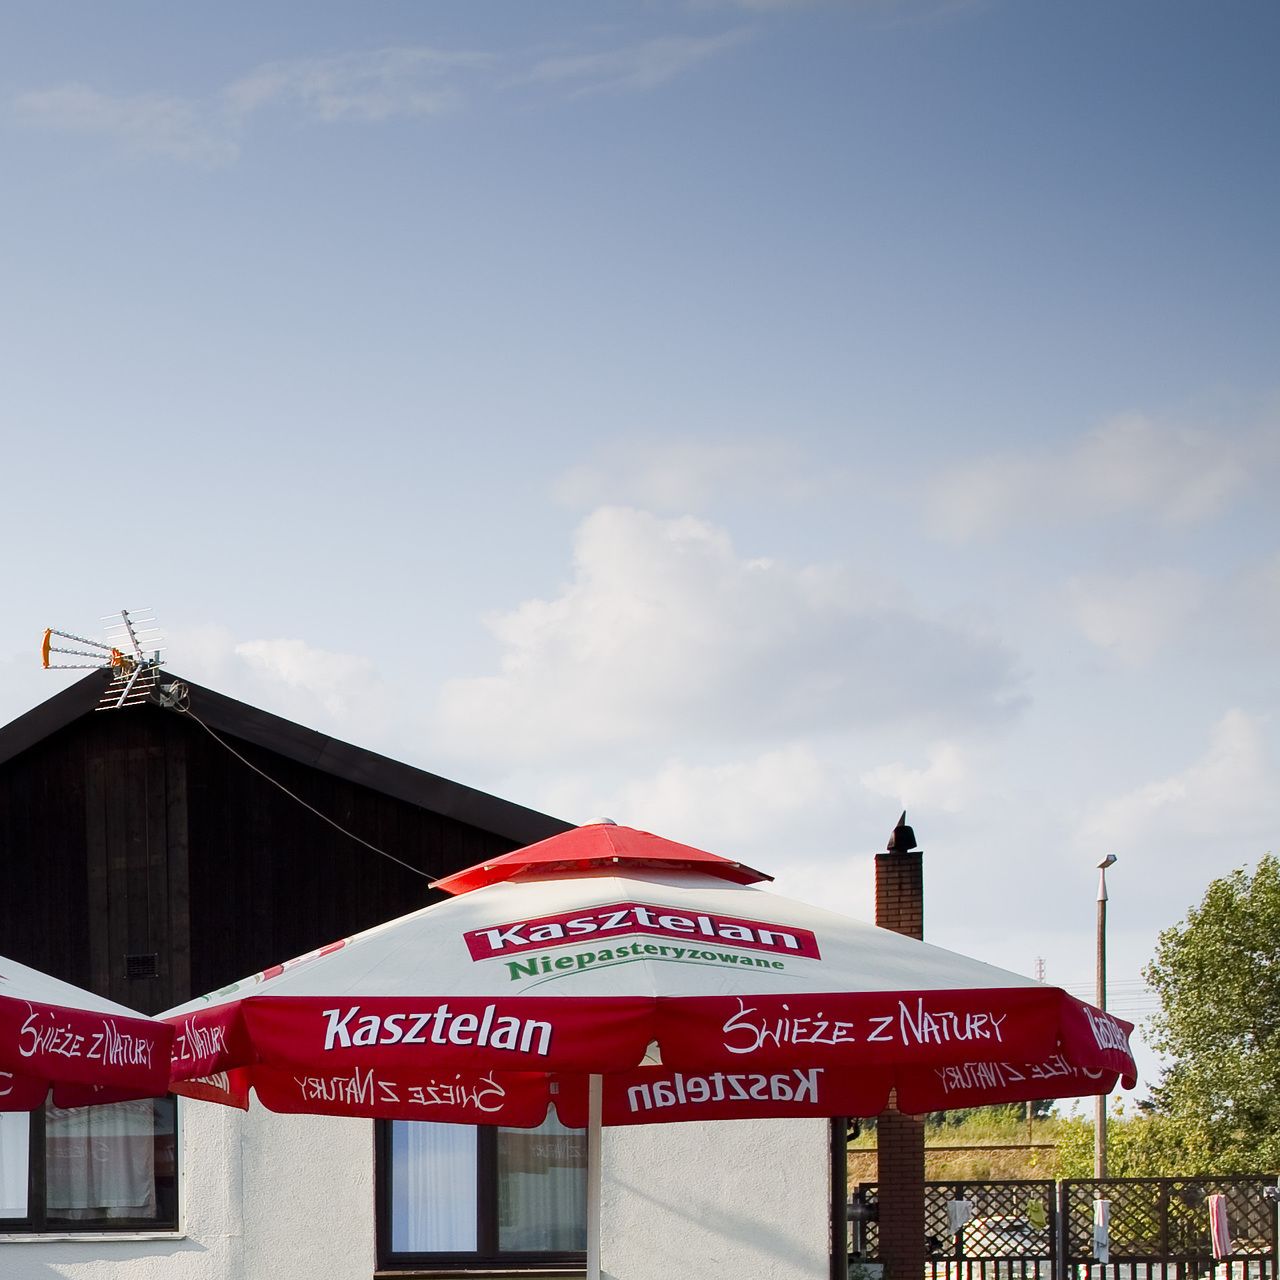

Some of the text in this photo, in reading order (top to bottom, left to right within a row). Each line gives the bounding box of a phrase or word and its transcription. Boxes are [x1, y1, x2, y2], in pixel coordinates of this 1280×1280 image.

[474, 906, 800, 951] Kasztelan
[504, 941, 785, 982] Niepasteryzowane
[322, 1004, 553, 1056] Kasztelan
